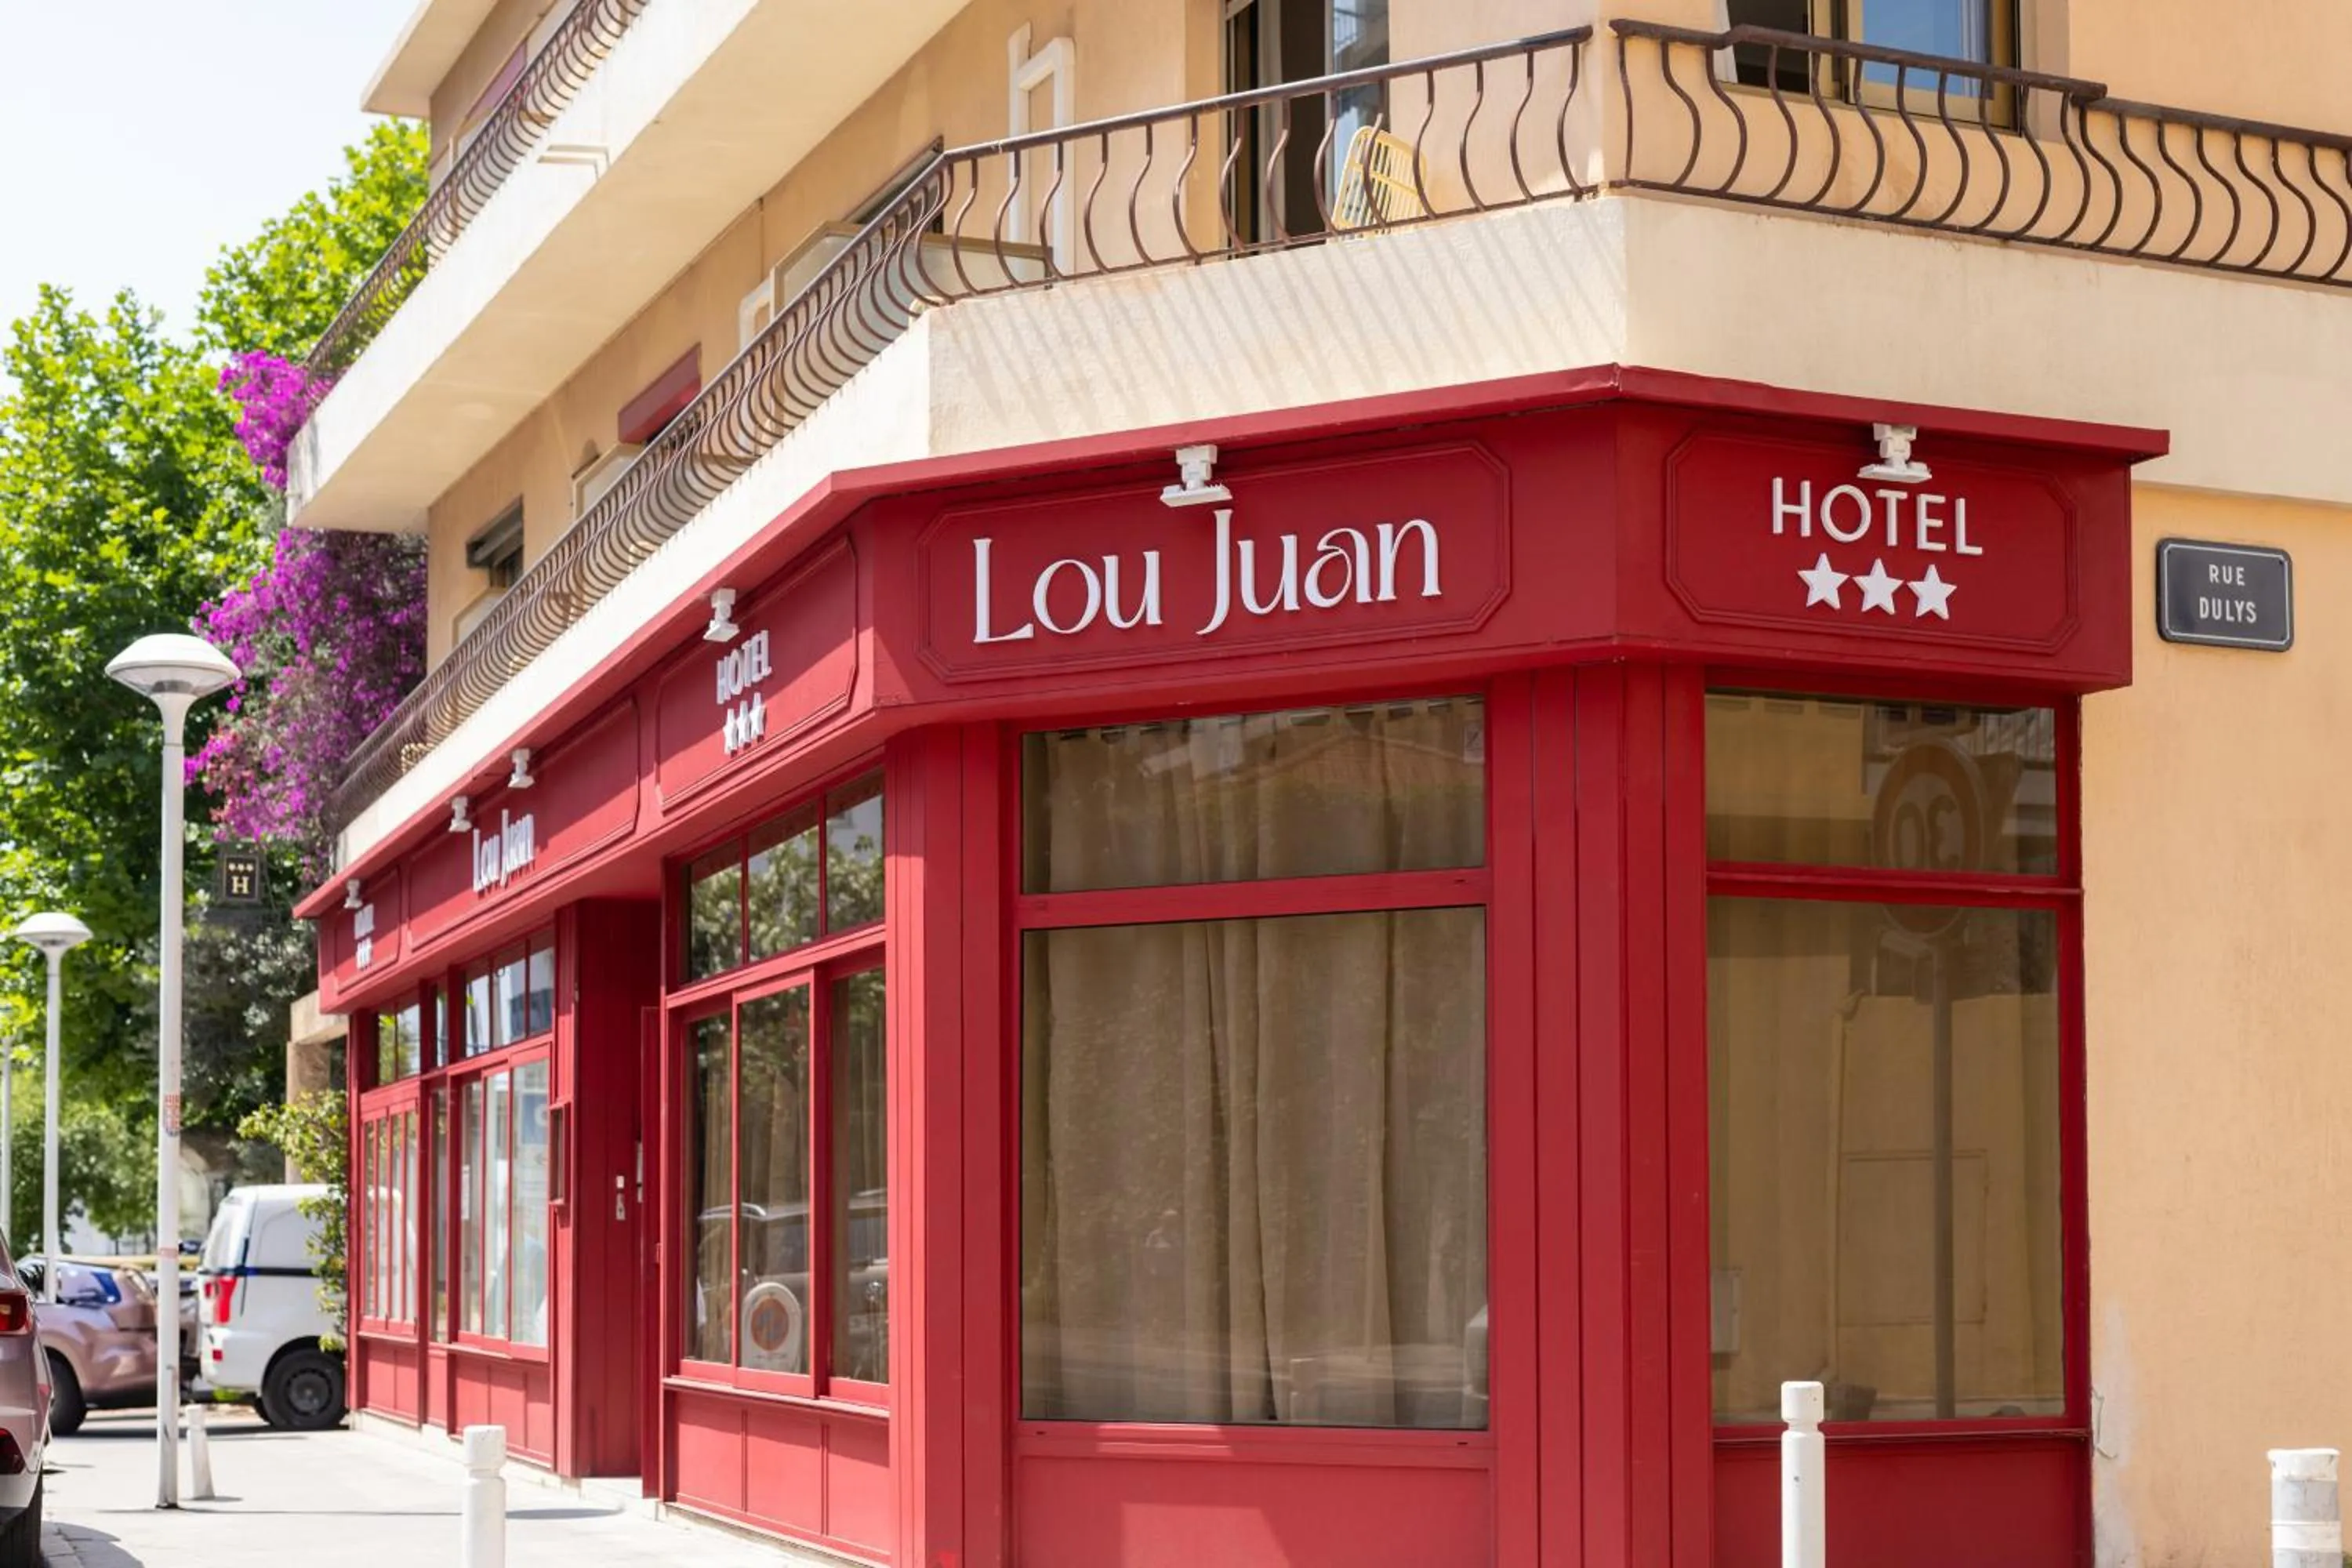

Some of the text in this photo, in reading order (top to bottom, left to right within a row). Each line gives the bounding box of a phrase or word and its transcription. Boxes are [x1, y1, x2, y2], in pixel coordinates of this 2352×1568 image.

[1772, 477, 1984, 555] HOTEL
[973, 509, 1442, 644] Lou Juan
[2209, 564, 2245, 586] RUE
[2199, 596, 2257, 624] DULYS
[716, 630, 772, 705] HOTEL
[231, 876, 250, 895] H
[473, 828, 500, 893] Lou
